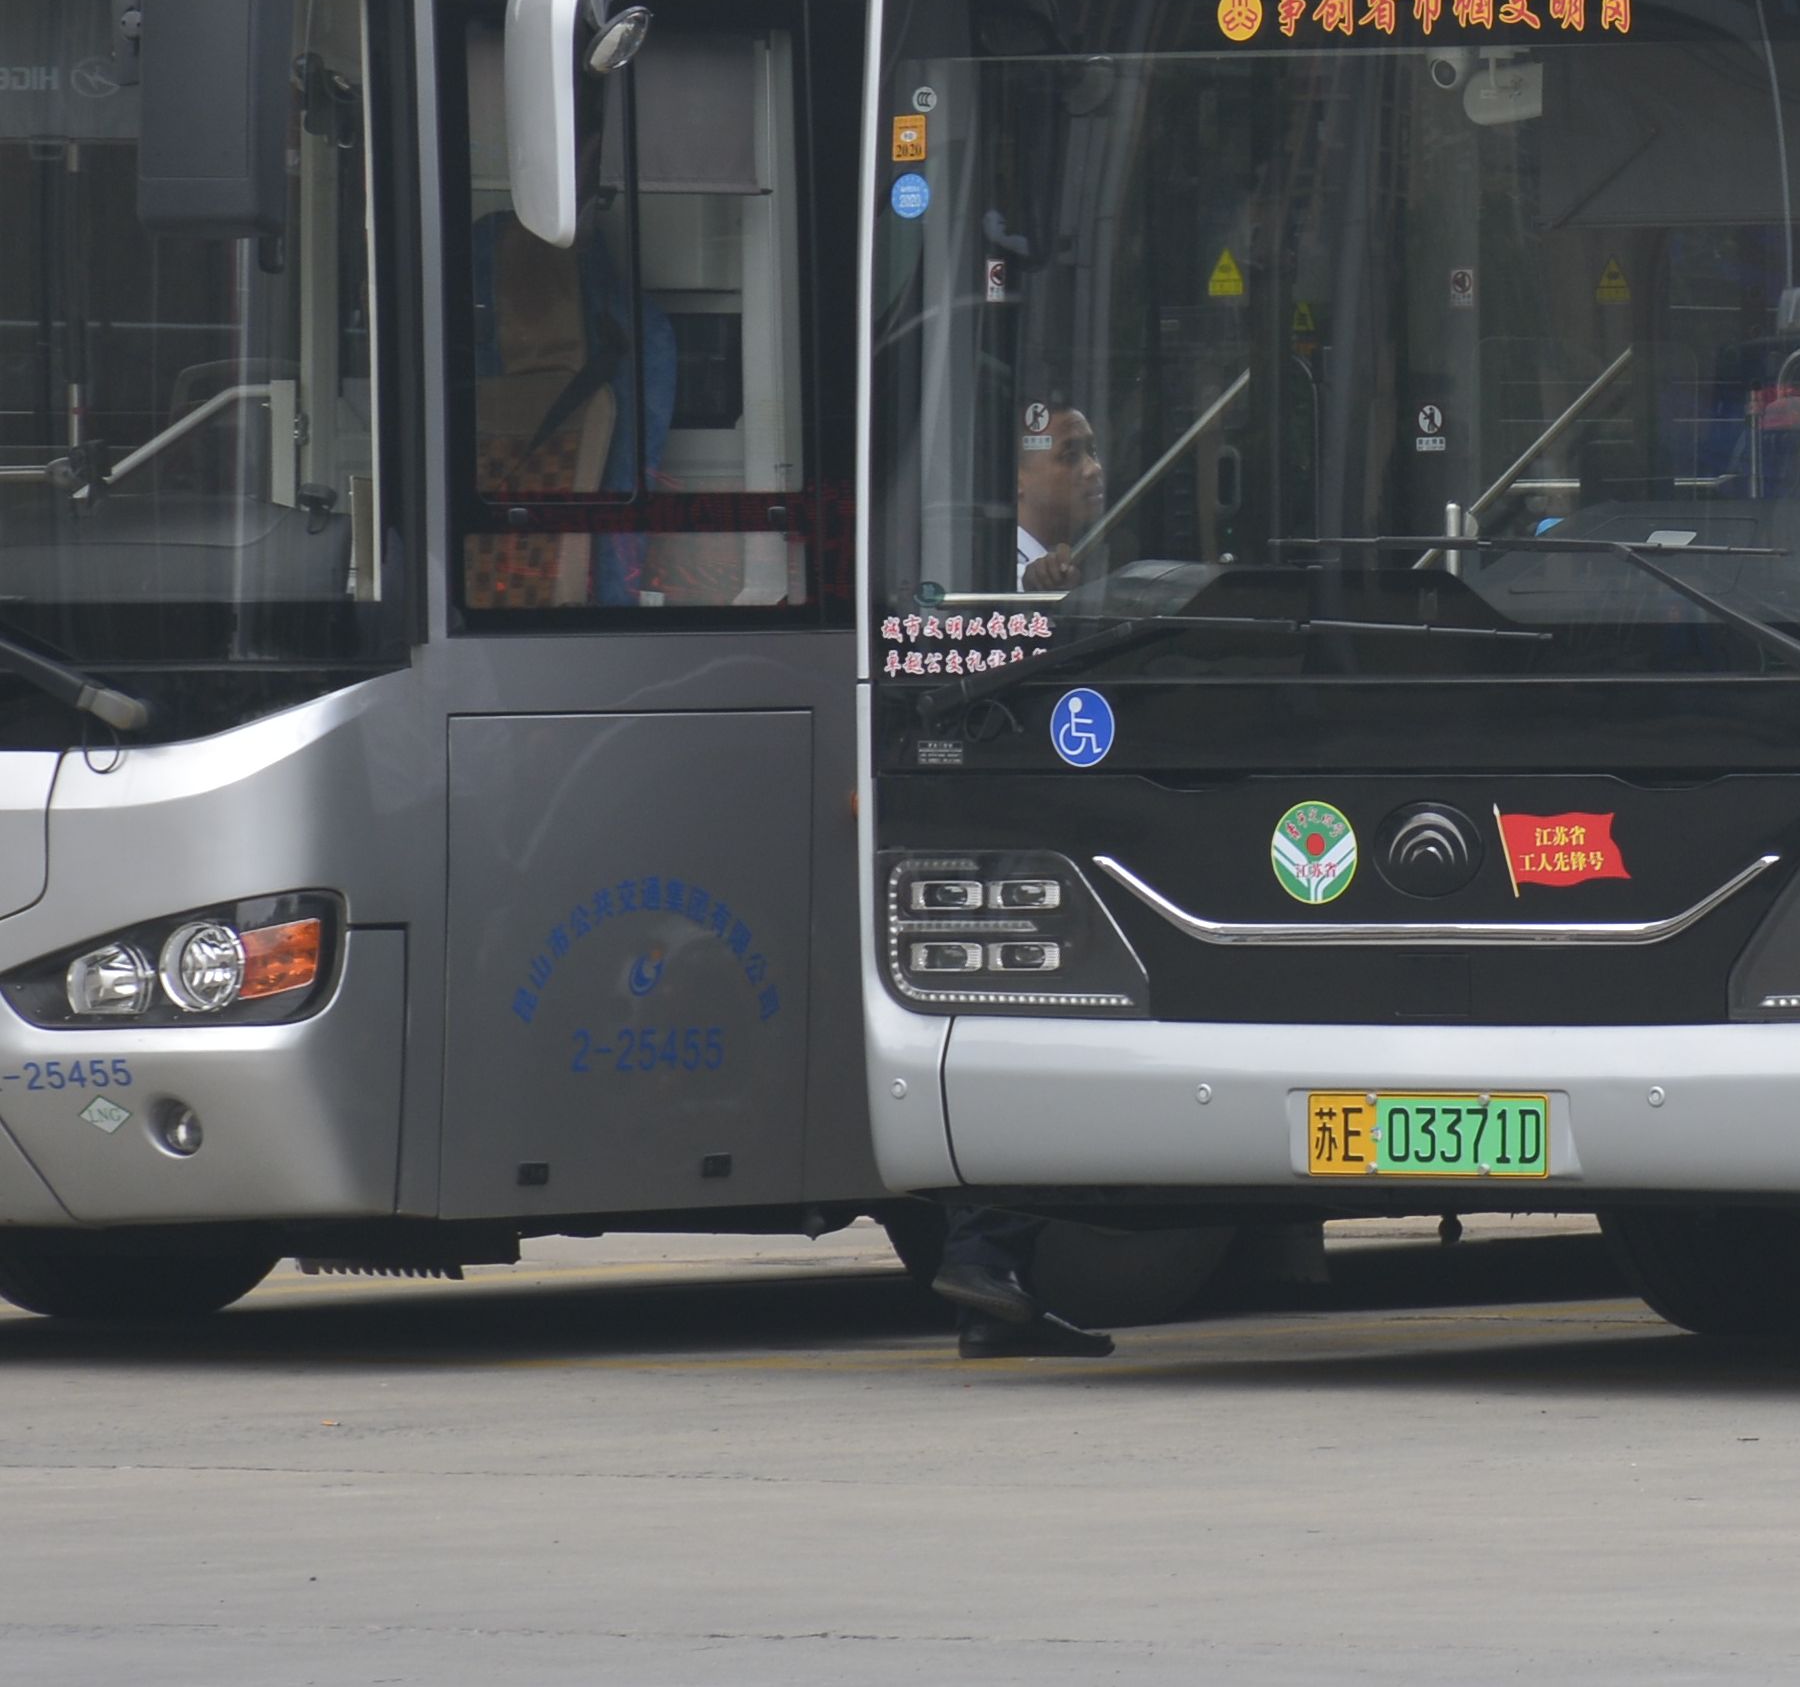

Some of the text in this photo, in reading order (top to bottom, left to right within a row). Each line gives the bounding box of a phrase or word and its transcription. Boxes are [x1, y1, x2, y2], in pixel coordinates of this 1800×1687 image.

[896, 143, 922, 158] 2020
[881, 611, 1052, 643] 城市文明从我做起
[884, 646, 1048, 678] 卓越公交礼让先
[1535, 825, 1586, 846] 江苏省
[1519, 851, 1605, 872] 工人先锋号
[570, 1026, 726, 1074] 2-25455
[0, 1059, 133, 1091] -25455
